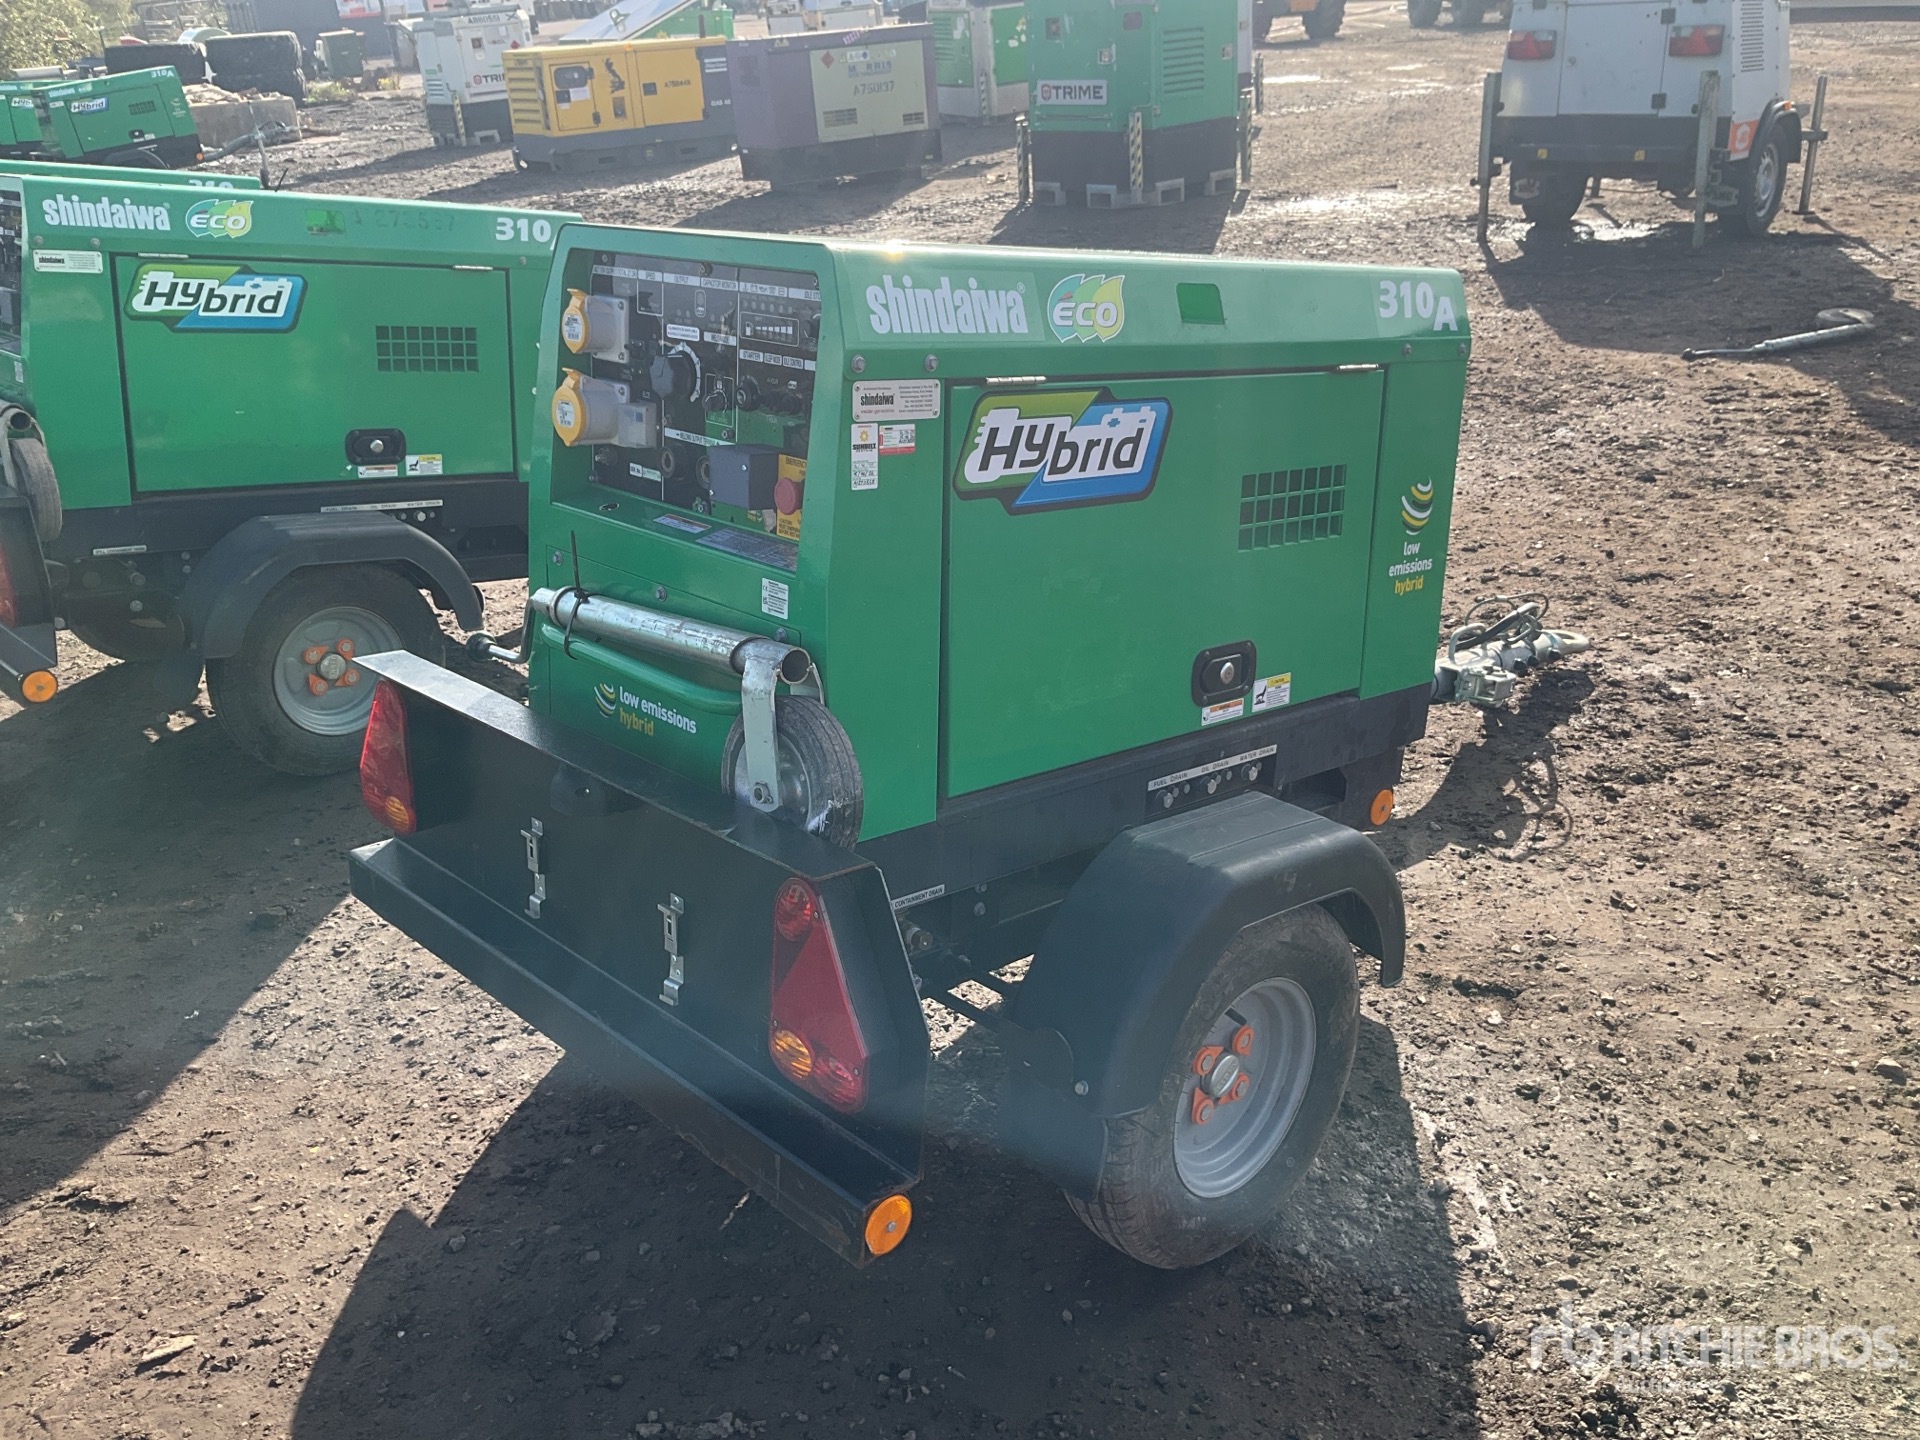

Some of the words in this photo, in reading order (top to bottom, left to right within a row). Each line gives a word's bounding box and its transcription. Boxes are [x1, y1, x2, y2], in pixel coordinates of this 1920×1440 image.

[848, 61, 892, 74] MRRIS
[482, 73, 505, 83] TRI
[1052, 86, 1103, 100] TRIME
[73, 101, 104, 111] Hybrid
[42, 194, 170, 231] shindaiwa
[190, 214, 246, 229] ECO
[495, 217, 556, 250] 310
[144, 281, 283, 314] Hybrid
[866, 274, 1028, 334] shindaiwa
[1379, 280, 1458, 331] 310A
[1053, 302, 1118, 327] ECO
[743, 351, 760, 360] STARTER
[861, 392, 894, 406] shindaiwa
[978, 424, 1144, 475] Hybrid
[786, 457, 807, 468] EMERGENC
[1404, 541, 1420, 556] low
[1389, 558, 1432, 577] emissions
[1394, 575, 1424, 596] hybrid
[620, 686, 639, 709] low
[641, 699, 696, 734] emissions
[620, 707, 654, 737] hybrid
[1240, 753, 1257, 761] WATER
[1259, 747, 1274, 756] DRAIN
[1212, 761, 1229, 769] DRAIN
[1153, 779, 1167, 787] FUEL
[1170, 772, 1188, 780] DRAIN
[895, 893, 928, 907] CONTAINMENT
[928, 888, 943, 897] DRAIN
